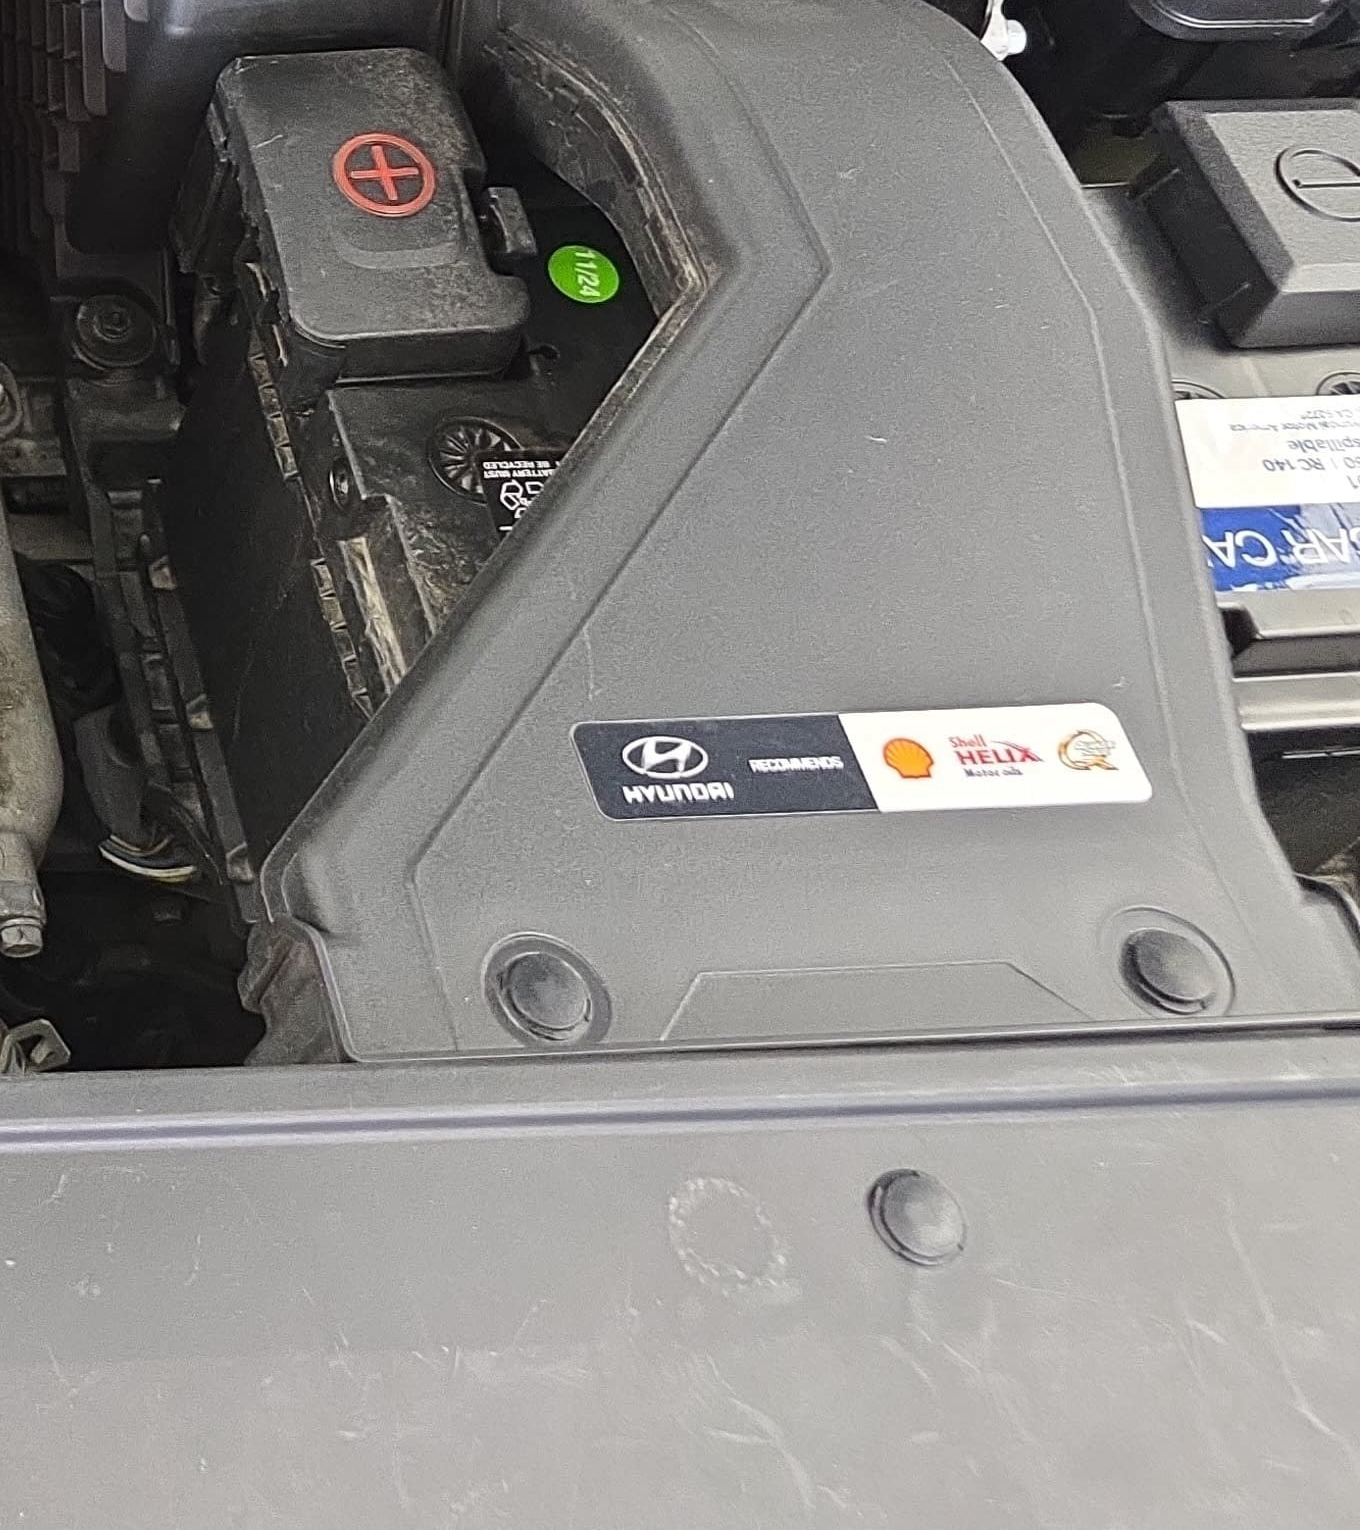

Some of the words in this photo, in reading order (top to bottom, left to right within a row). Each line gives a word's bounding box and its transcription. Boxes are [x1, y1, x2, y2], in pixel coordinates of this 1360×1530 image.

[574, 250, 601, 297] 11/24
[1262, 457, 1296, 472] 140
[1202, 528, 1278, 569] CA
[1281, 526, 1360, 568] AR
[948, 733, 988, 749] Shell
[748, 755, 844, 773] RECOMMENDS
[954, 743, 1042, 766] HELIX
[622, 781, 735, 805] HYUNDAI
